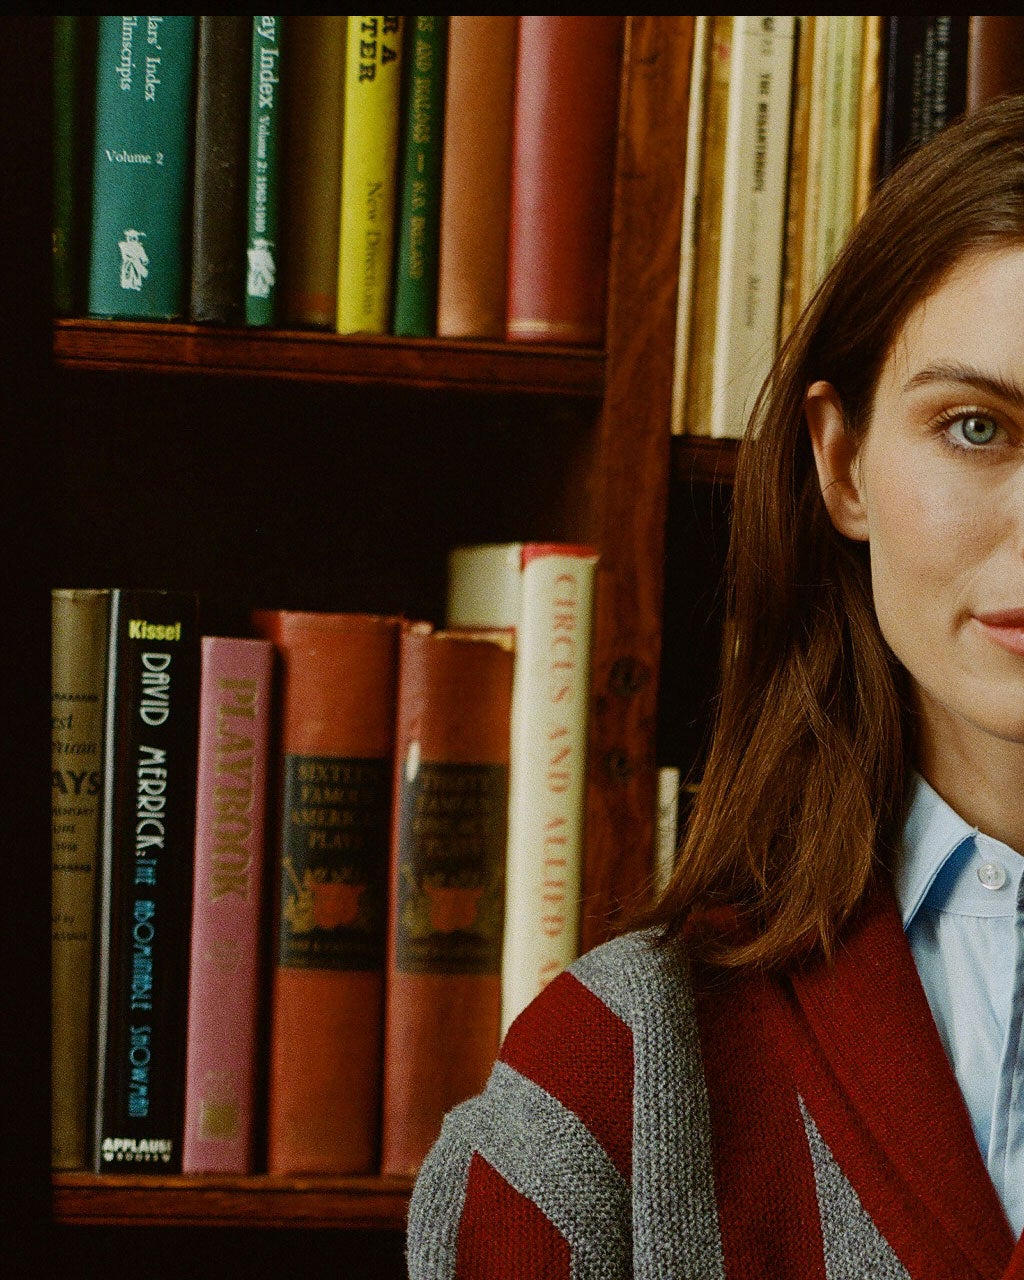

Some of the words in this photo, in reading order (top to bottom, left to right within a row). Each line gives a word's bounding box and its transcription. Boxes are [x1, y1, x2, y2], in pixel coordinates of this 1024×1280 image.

[257, 16, 276, 42] ay
[358, 18, 378, 84] TER
[381, 44, 397, 66] A
[415, 39, 433, 72] AND
[144, 57, 162, 102] Index
[257, 47, 280, 109] Index
[105, 149, 151, 164] Volume
[155, 151, 164, 165] 2
[257, 115, 271, 159] Volume
[366, 181, 383, 222] New
[363, 231, 382, 315] Directions
[128, 619, 181, 641] Kissel
[551, 572, 578, 704] CIRCUS
[139, 651, 172, 726] DAVID
[547, 723, 573, 795] AND
[209, 678, 257, 901] PLAYBOOK
[134, 857, 158, 886] THE
[541, 815, 569, 939] ALLIED
[131, 900, 156, 1012] ABOMINABLE
